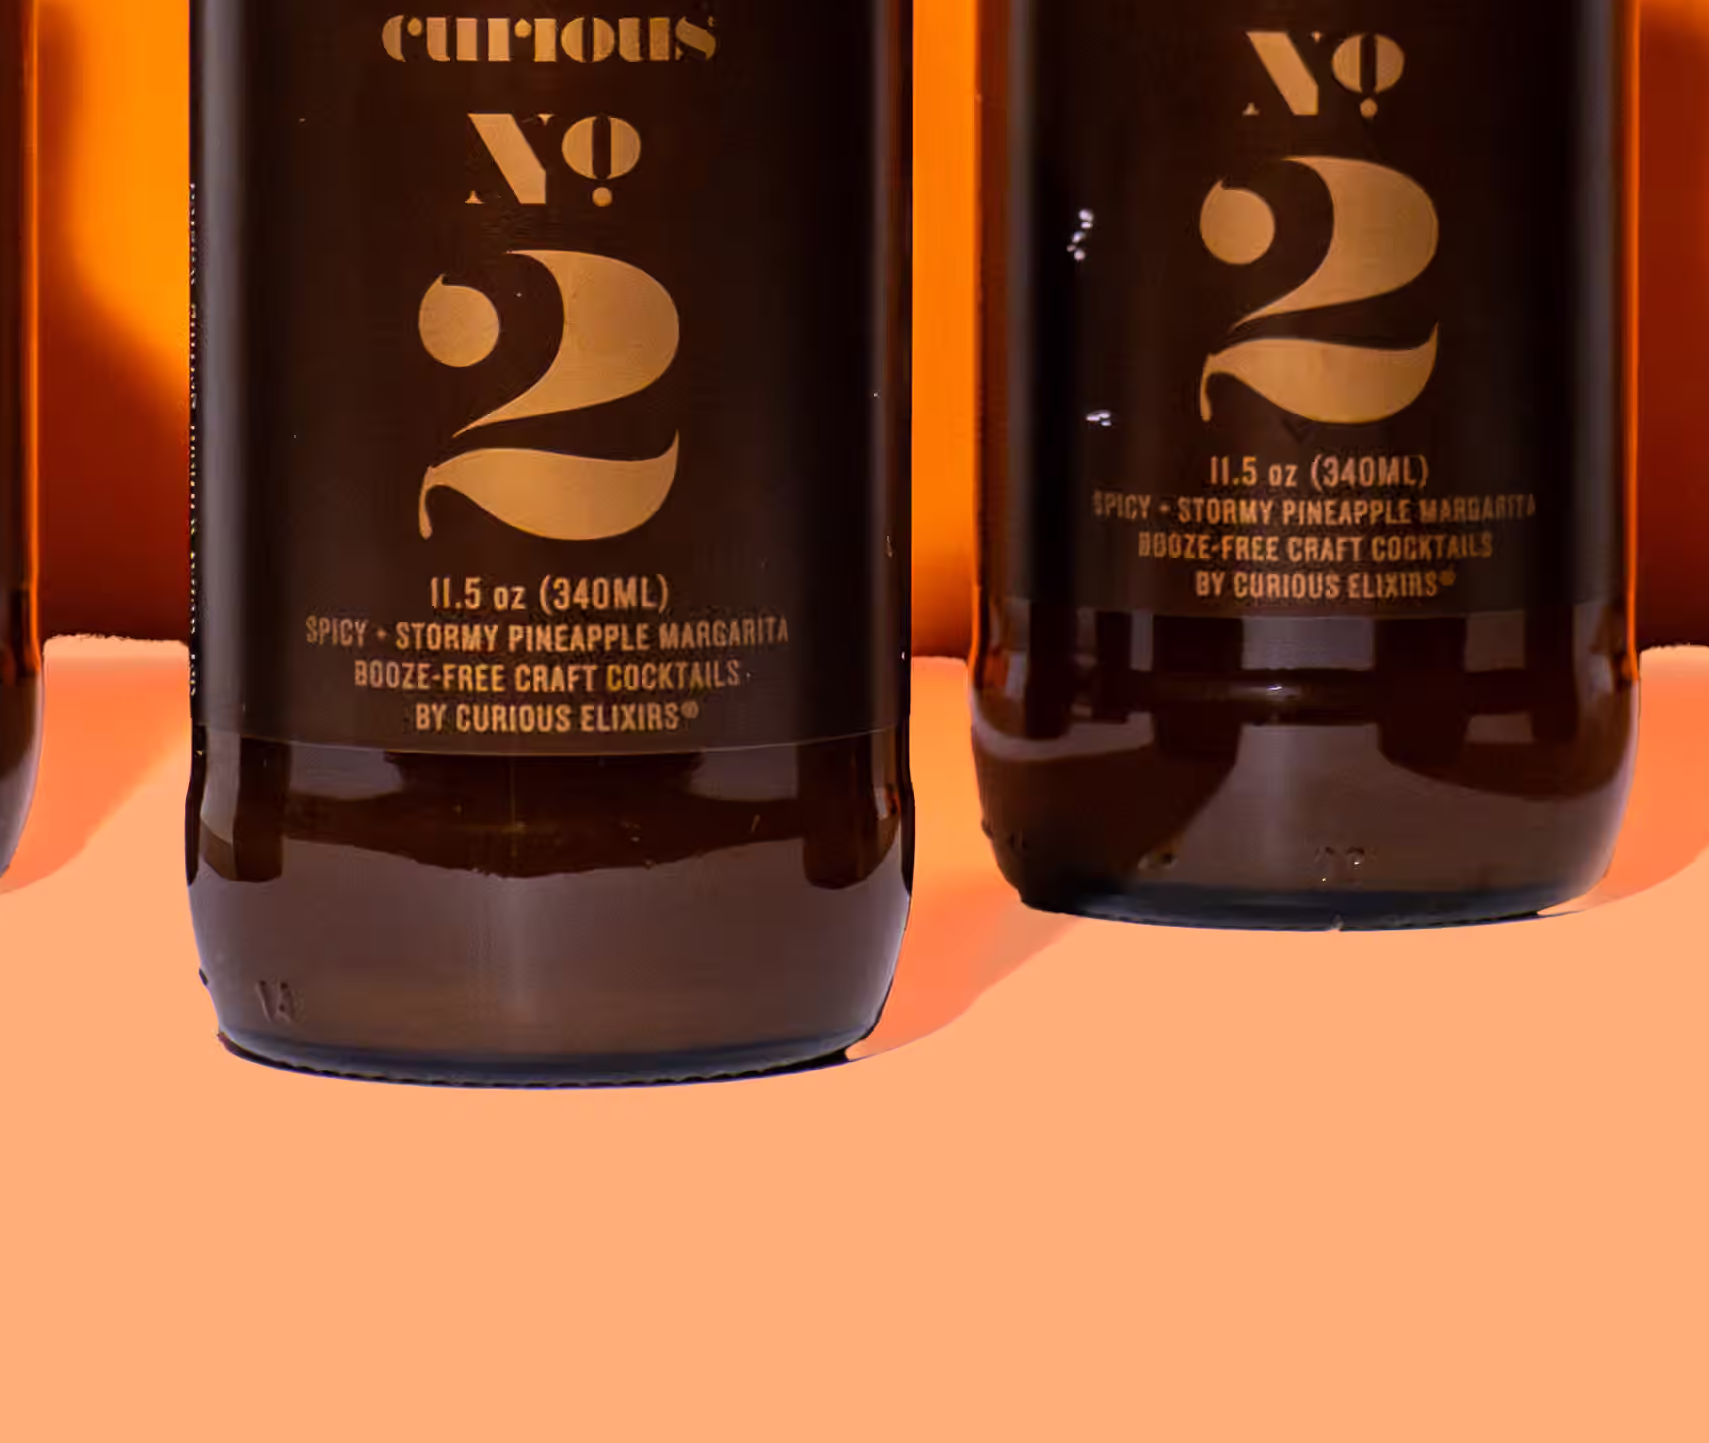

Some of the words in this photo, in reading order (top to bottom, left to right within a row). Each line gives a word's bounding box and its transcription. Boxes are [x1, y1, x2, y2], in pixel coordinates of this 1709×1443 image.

[382, 14, 717, 63] curious
[1199, 156, 1440, 424] 2
[417, 249, 680, 541] 2
[1210, 456, 1257, 486] 11.5
[1269, 464, 1297, 487] oz
[1094, 490, 1151, 519] SPICY
[1178, 497, 1274, 524] STORMY
[1282, 499, 1411, 525] PINEAPPLE
[1139, 532, 1279, 561] BOOZE-FREE
[1289, 536, 1363, 562] CRAFT
[1372, 533, 1493, 560] COCKTAILS
[430, 576, 481, 609] 11.5
[493, 586, 526, 611] oz
[1196, 571, 1224, 597] BY
[1233, 572, 1339, 598] CURIOUS
[305, 616, 368, 647] SPICY
[395, 622, 499, 651] STORMY
[508, 623, 649, 652] PINEAPPLE
[658, 617, 788, 649] MARGARITA
[355, 661, 504, 692] BOOZE-FREE
[515, 664, 596, 692] CRAFT
[606, 660, 740, 691] COCKTAILS
[416, 704, 448, 732] BY
[456, 704, 571, 733] CURIOUS
